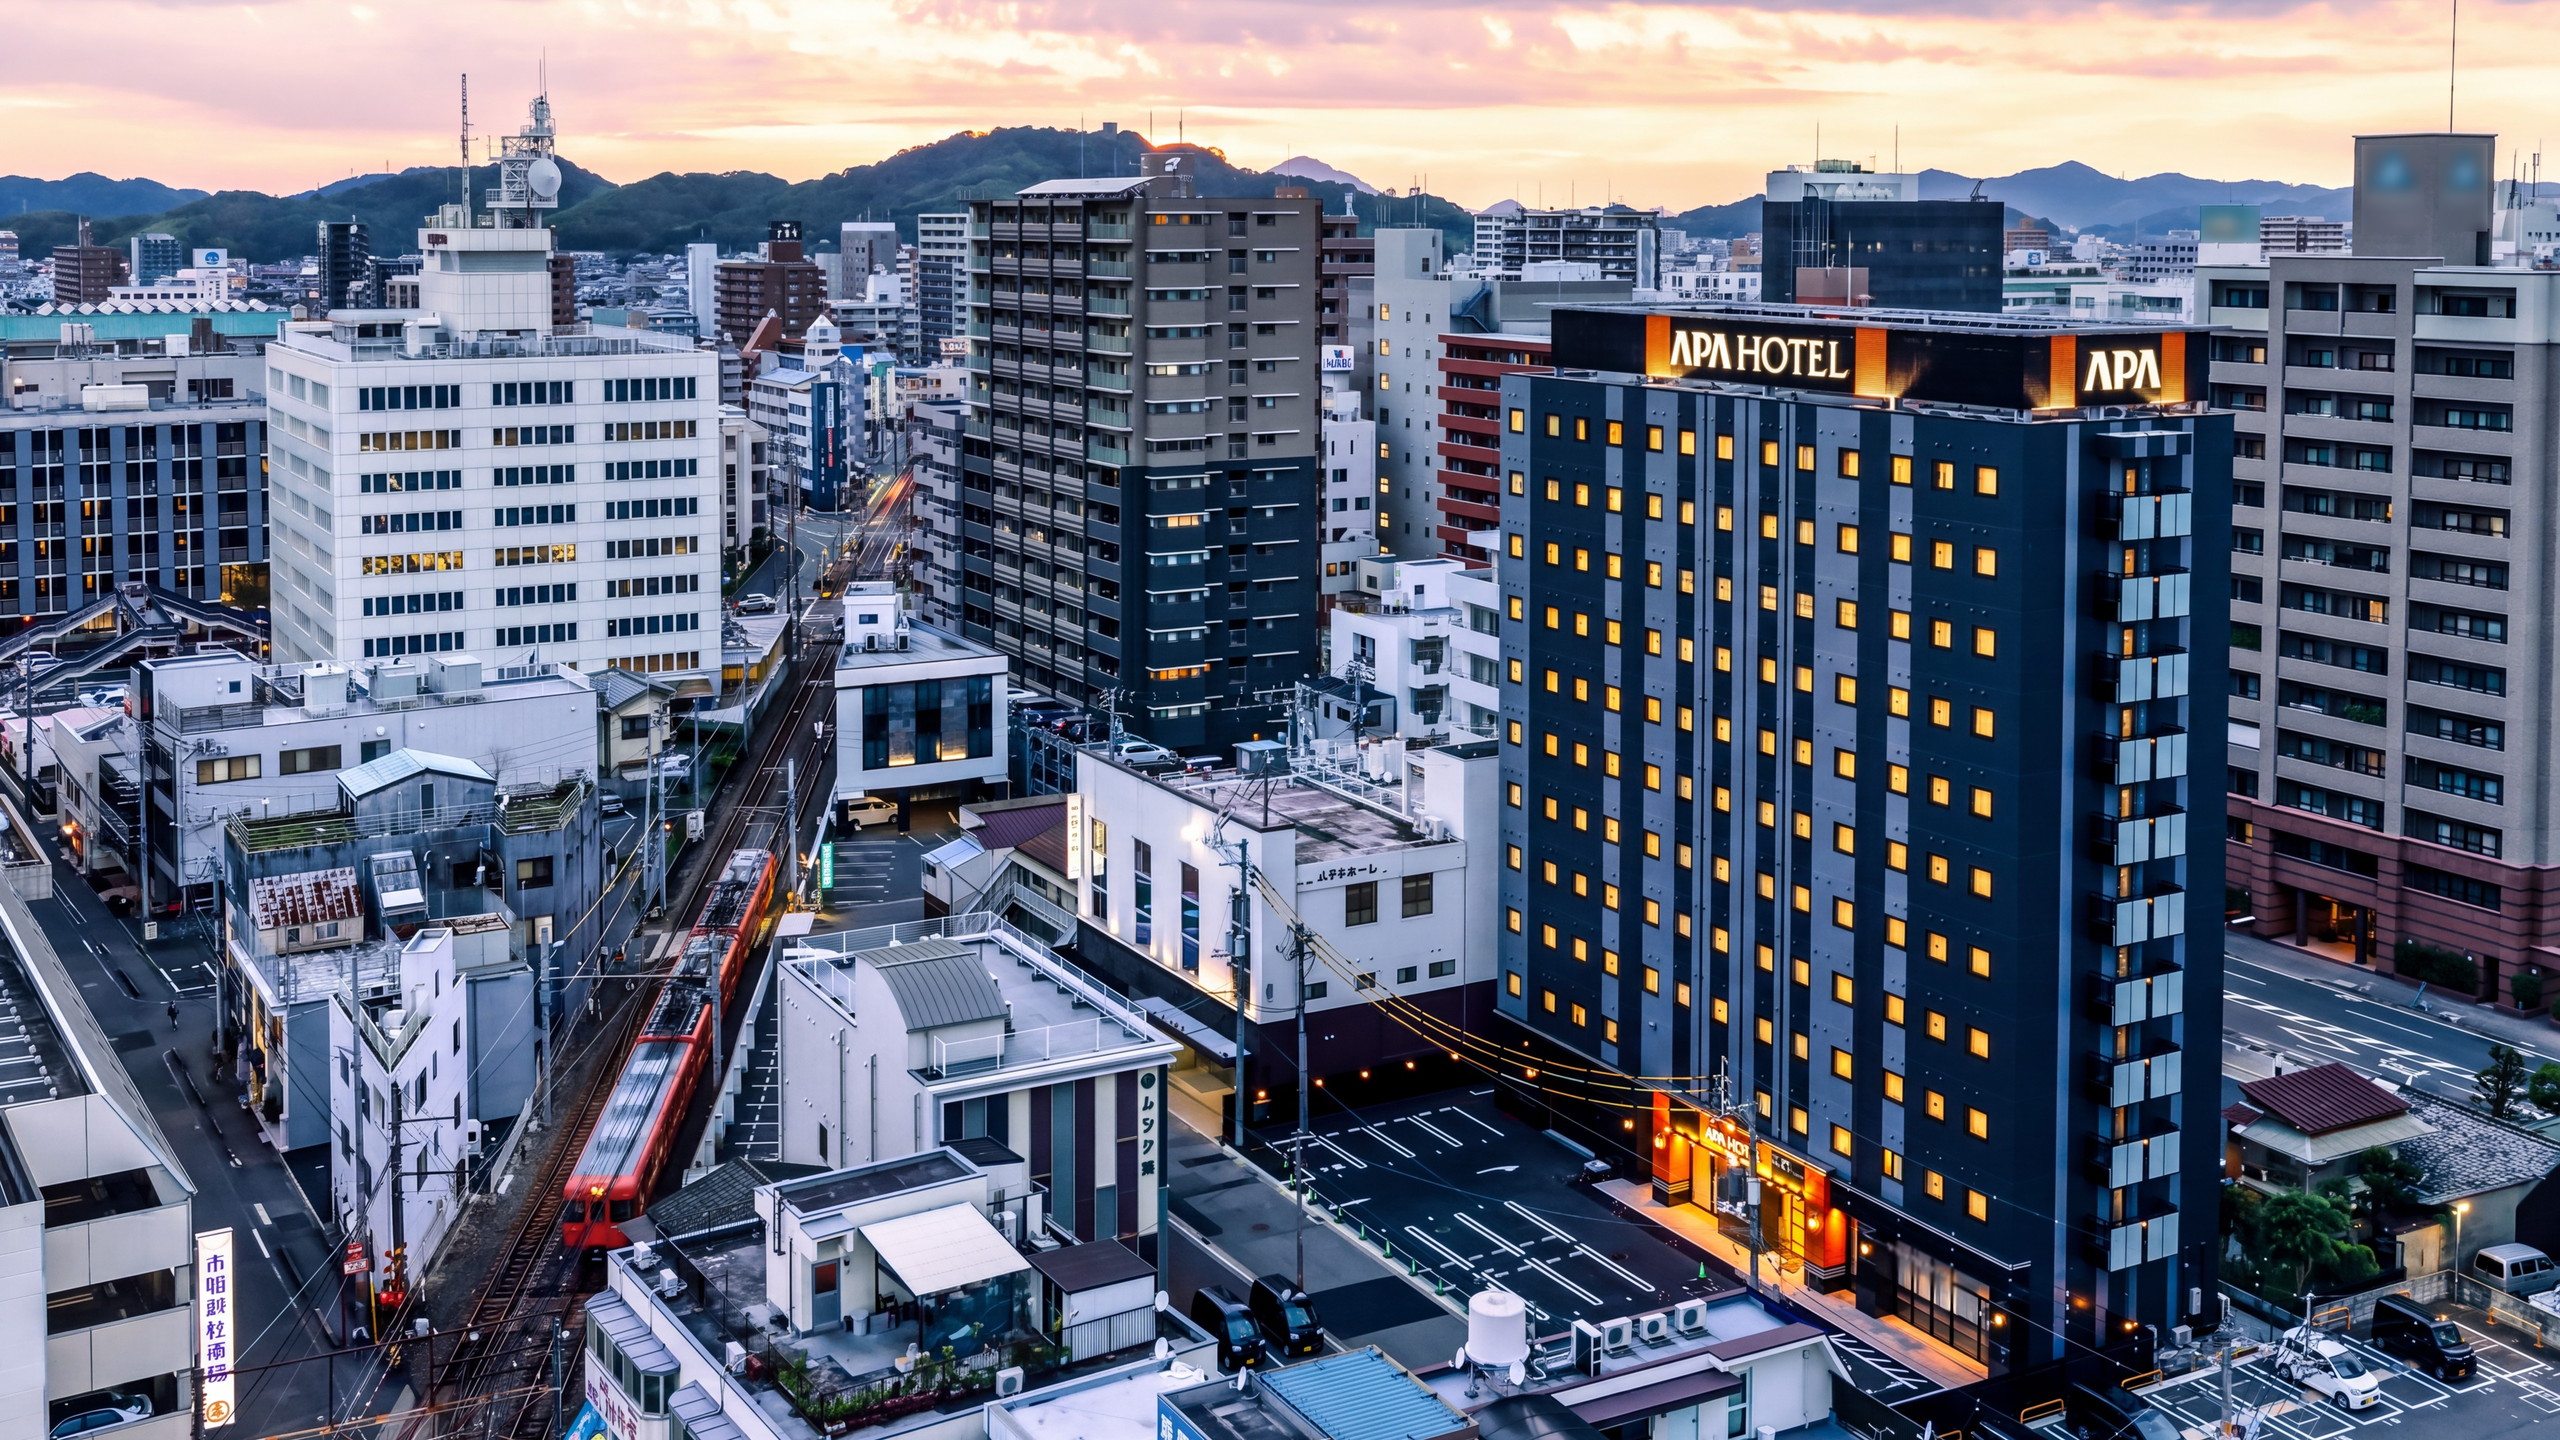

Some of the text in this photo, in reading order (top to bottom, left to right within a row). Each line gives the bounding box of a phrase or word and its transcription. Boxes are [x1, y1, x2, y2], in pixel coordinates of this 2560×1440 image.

[1670, 330, 1851, 379] APA HOTEL
[2083, 348, 2162, 392] APA
